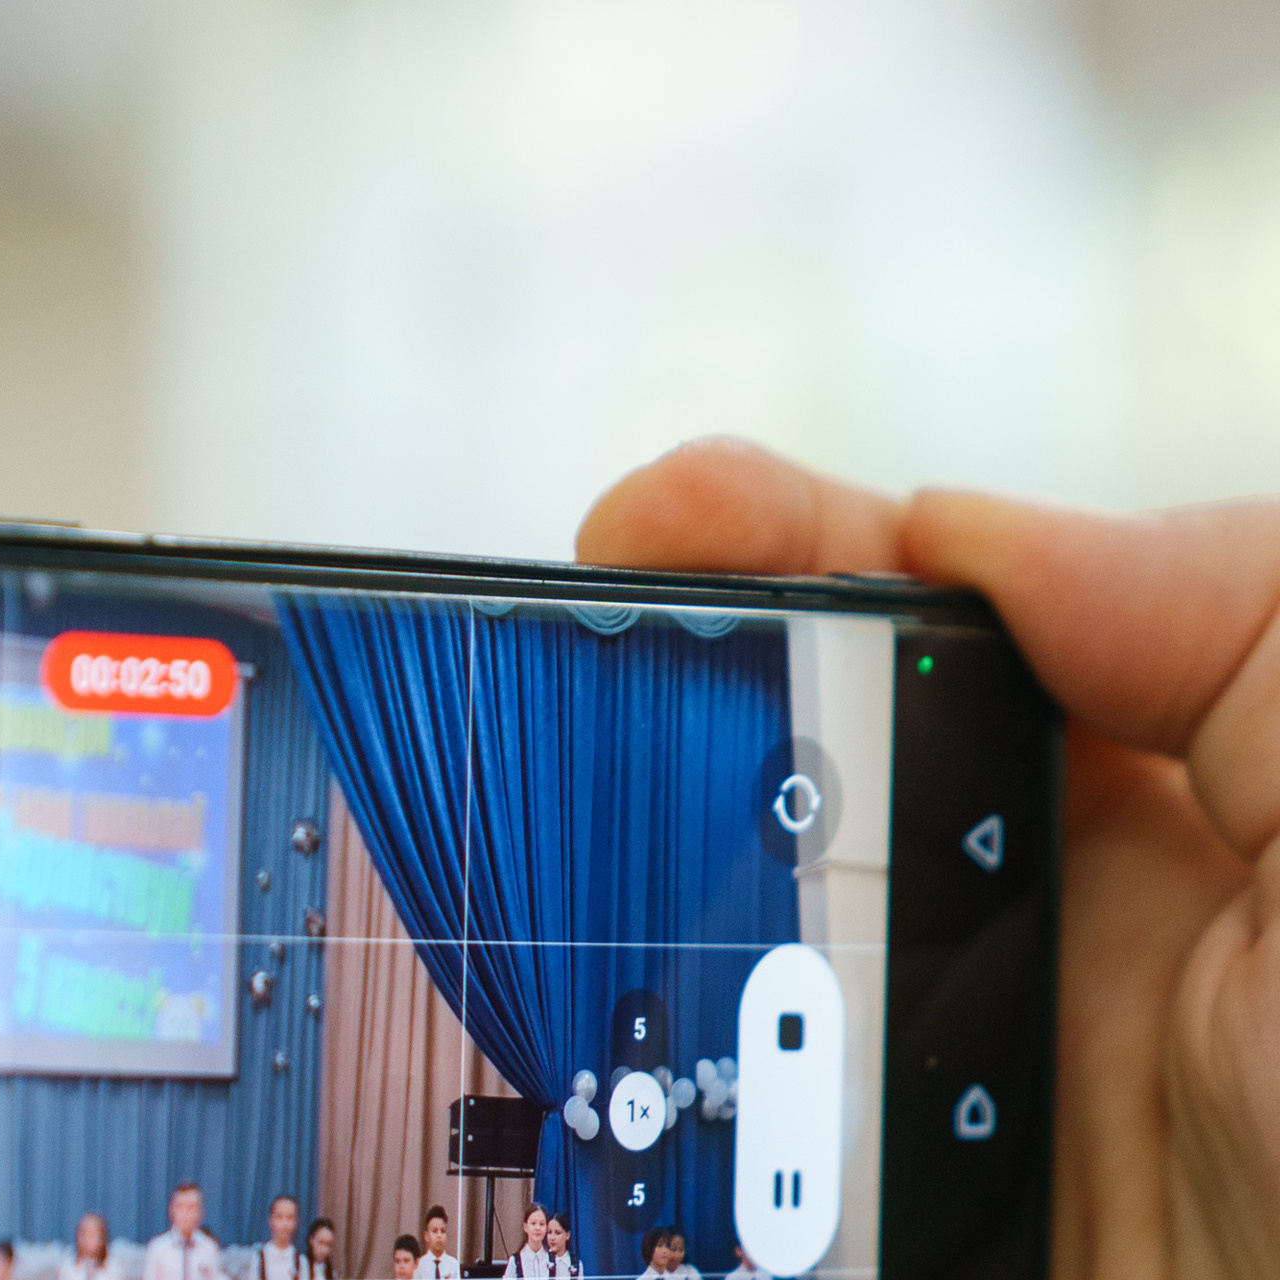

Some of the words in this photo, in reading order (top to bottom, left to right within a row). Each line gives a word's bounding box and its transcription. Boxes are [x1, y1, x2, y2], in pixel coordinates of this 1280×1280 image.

[71, 654, 210, 699] 00:02:50
[633, 1017, 646, 1040] 5
[627, 1099, 650, 1122] 1x
[627, 1183, 646, 1206] .5
